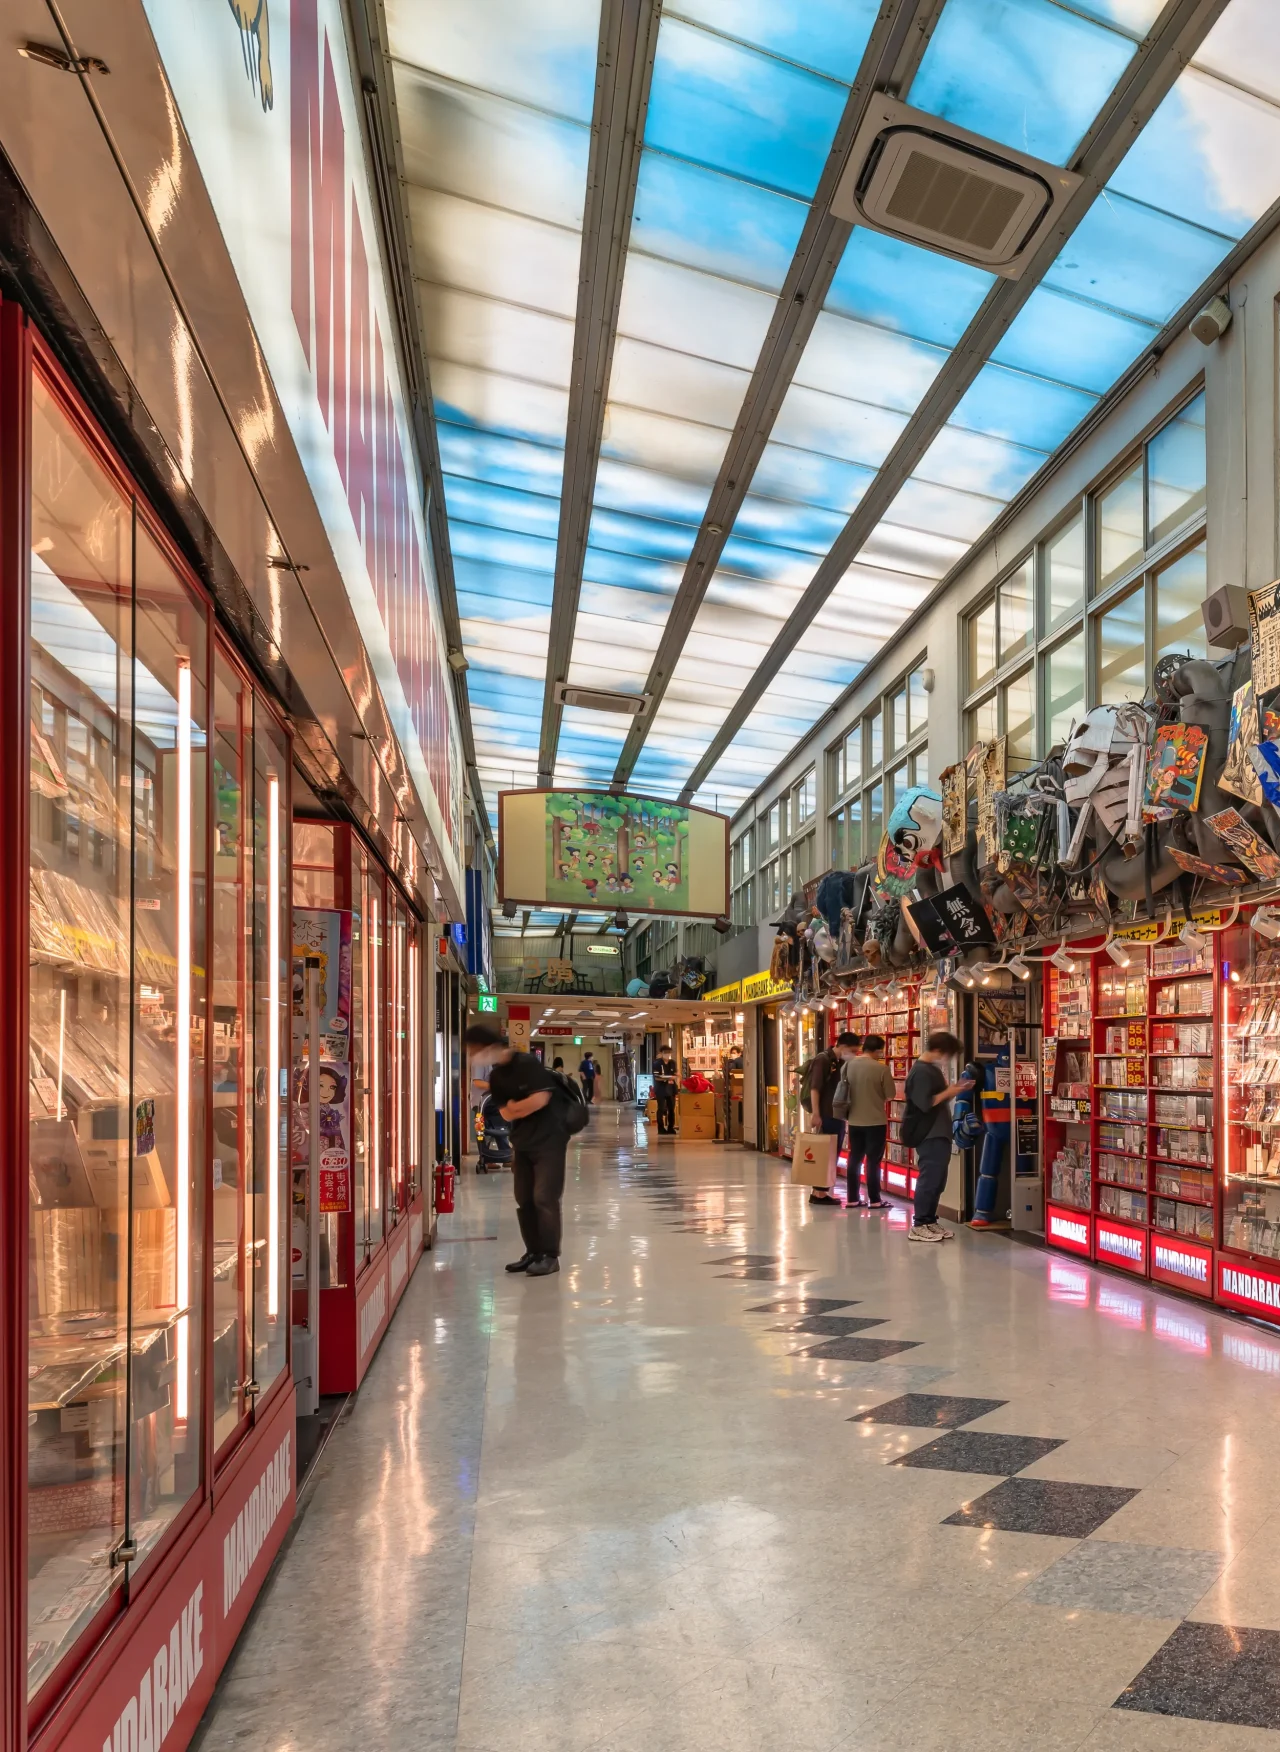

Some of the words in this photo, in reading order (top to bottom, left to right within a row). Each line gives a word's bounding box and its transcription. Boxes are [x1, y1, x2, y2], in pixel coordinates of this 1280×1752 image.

[946, 898, 982, 939] 無念
[514, 1022, 525, 1036] 3
[322, 1157, 348, 1166] 6/30
[324, 1172, 334, 1199] 出会った
[336, 1172, 346, 1200] 街で偶然
[1051, 1216, 1087, 1245] MANDARAKE
[1099, 1228, 1142, 1262] MANDARAKE
[1155, 1246, 1207, 1283] MANDARAKE
[223, 1429, 291, 1620] MANDARAKE
